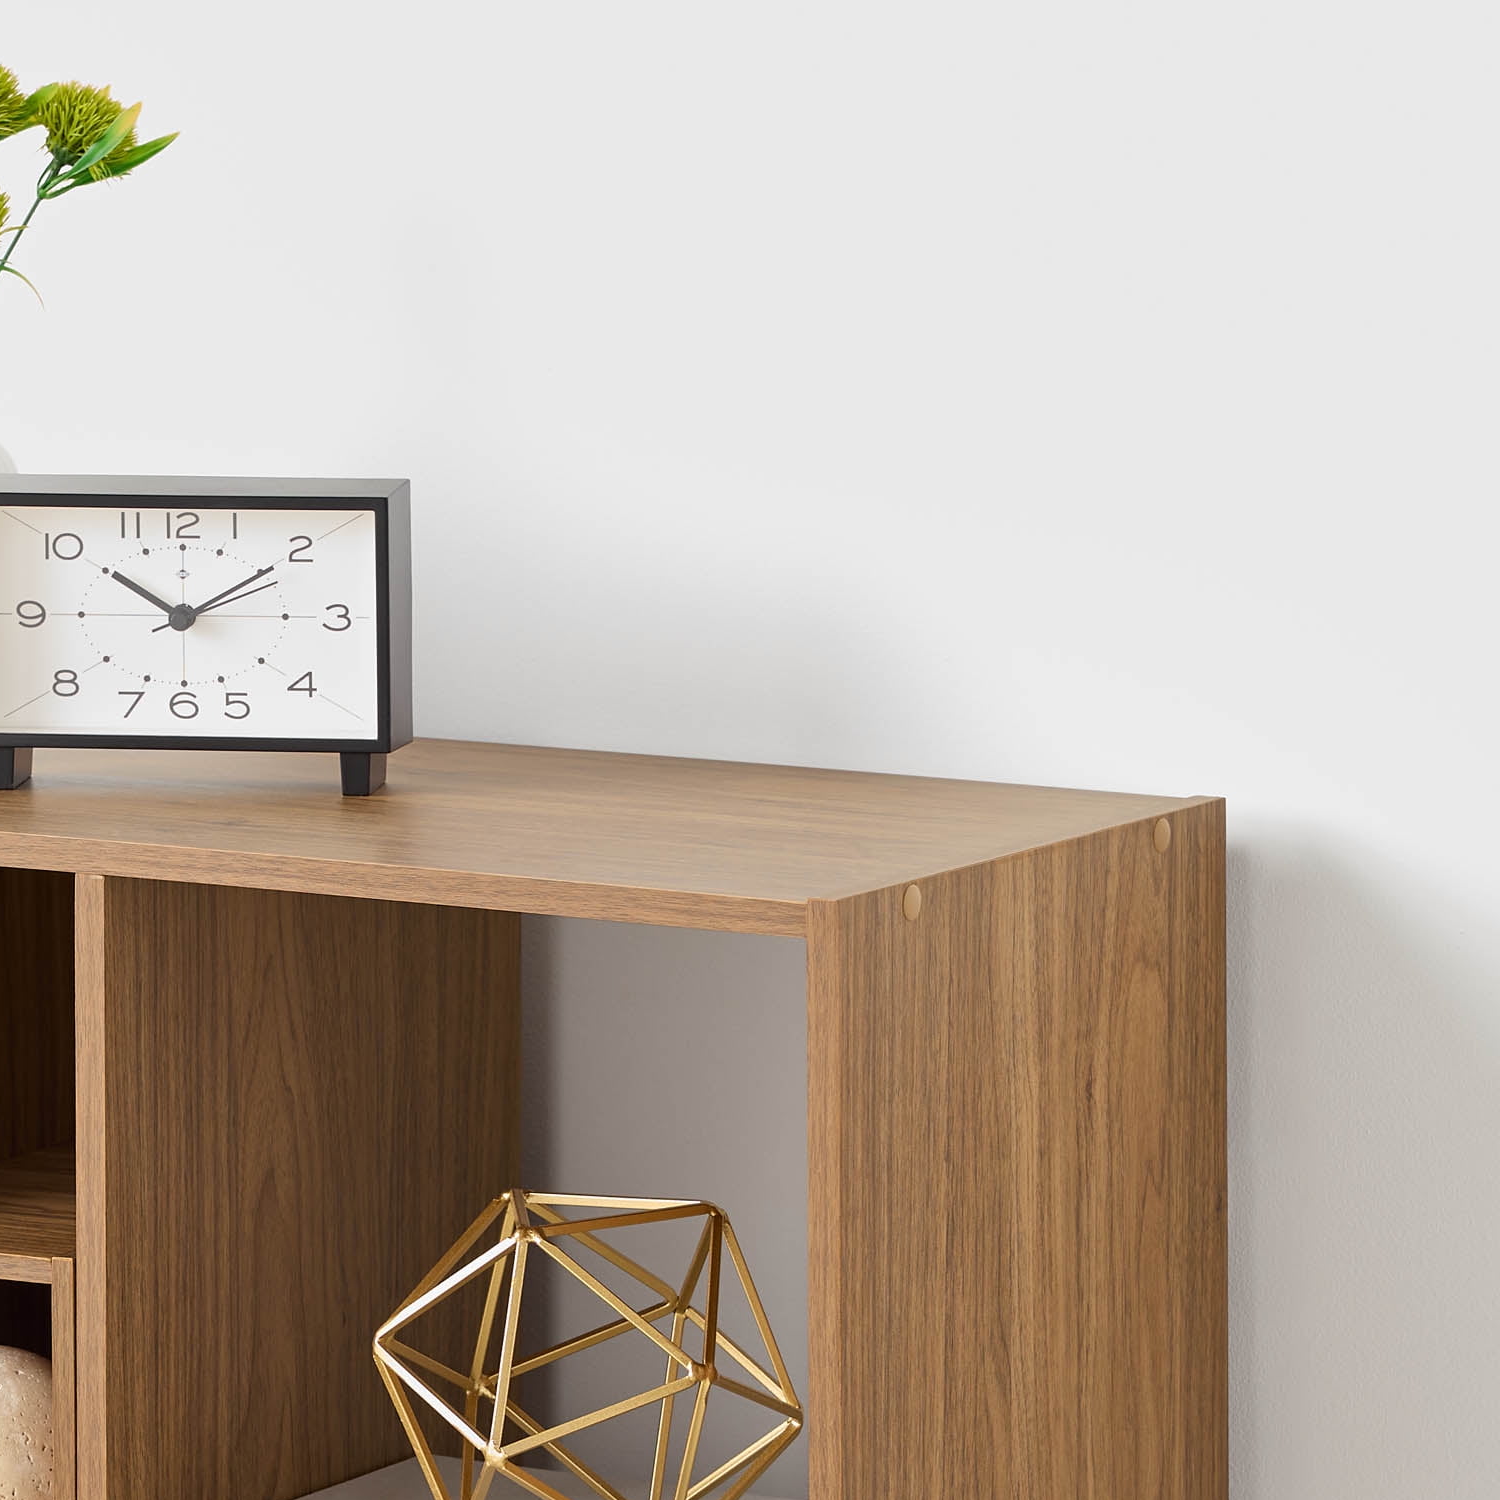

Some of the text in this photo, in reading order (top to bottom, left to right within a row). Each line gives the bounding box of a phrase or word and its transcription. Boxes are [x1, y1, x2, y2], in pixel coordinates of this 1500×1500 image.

[121, 511, 141, 539] 11
[166, 511, 201, 539] 12
[232, 512, 237, 540] 1
[44, 532, 84, 561] 10
[288, 535, 314, 563] 2
[16, 600, 46, 628] 9
[322, 603, 352, 632] 3
[52, 669, 80, 697] 8
[287, 671, 318, 698] 4
[118, 691, 145, 719] 7
[169, 691, 199, 720] 6
[224, 692, 251, 720] 5
